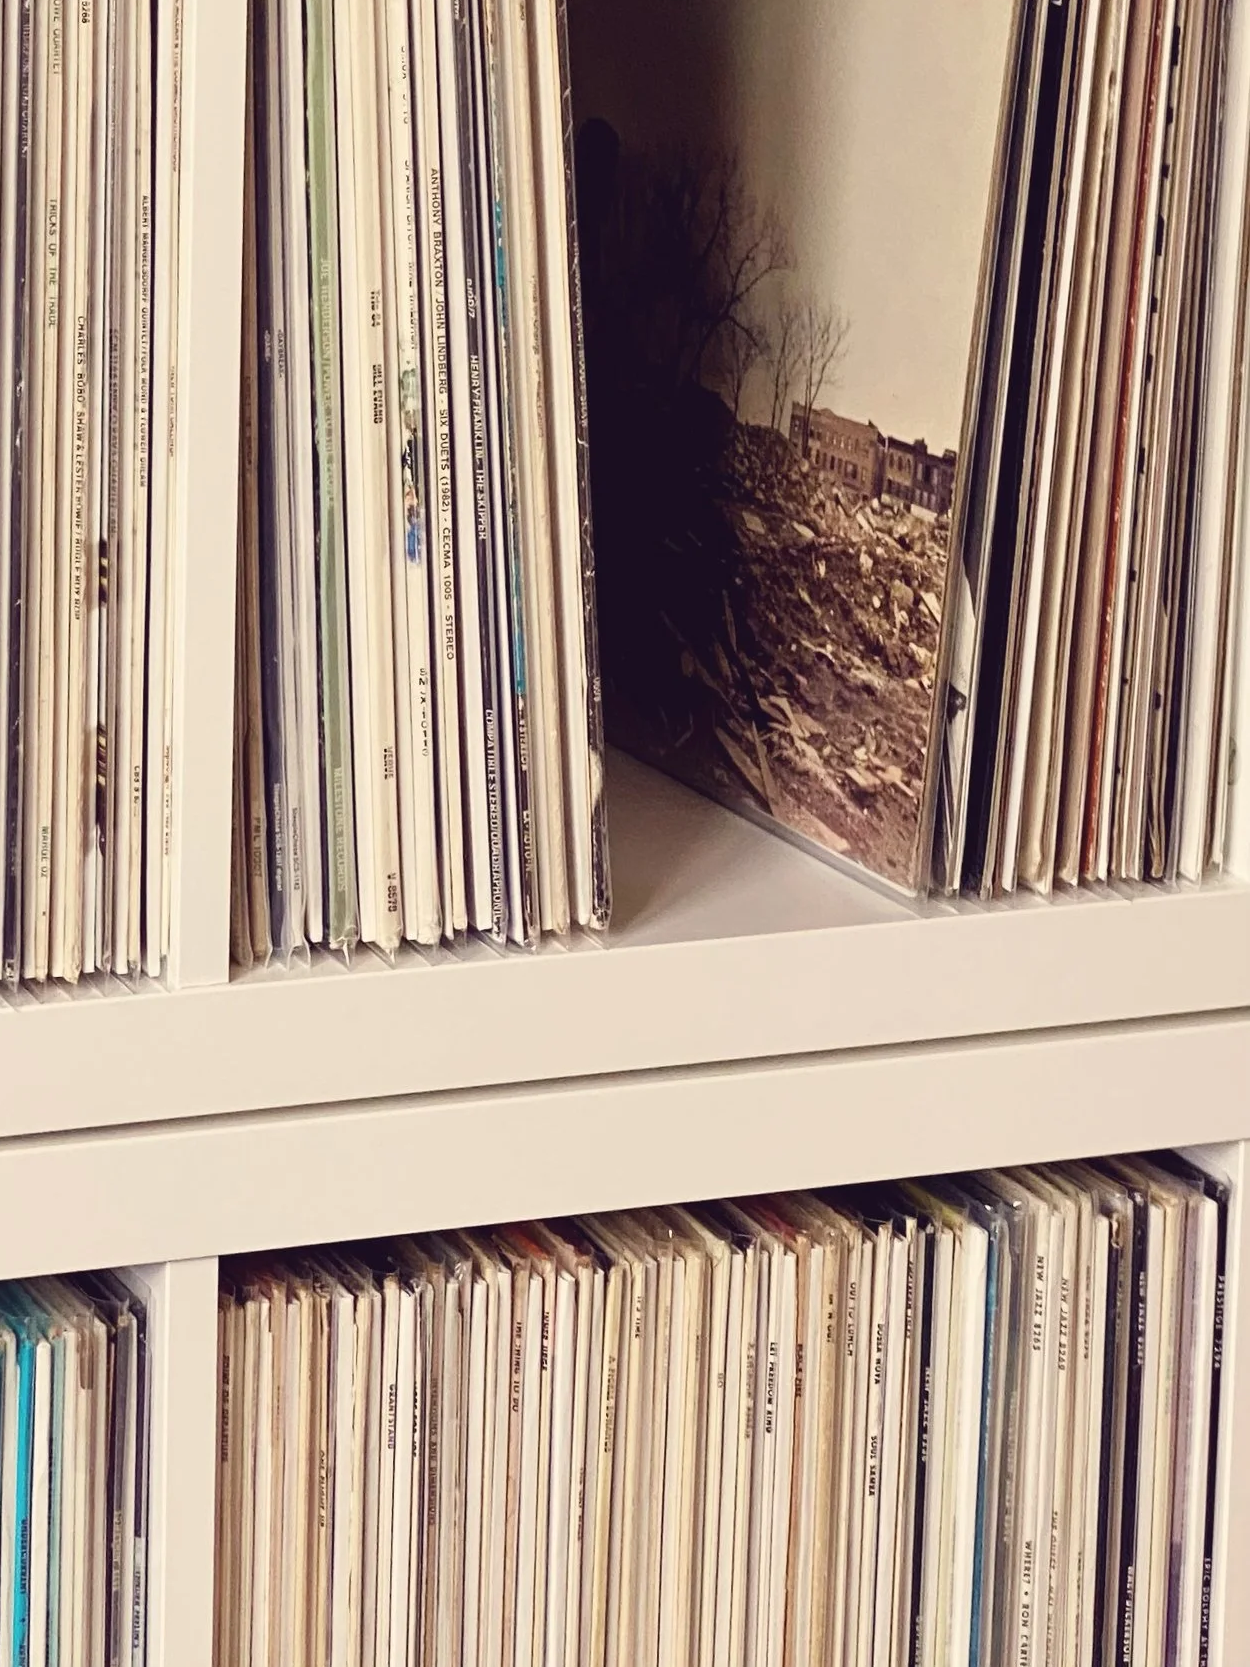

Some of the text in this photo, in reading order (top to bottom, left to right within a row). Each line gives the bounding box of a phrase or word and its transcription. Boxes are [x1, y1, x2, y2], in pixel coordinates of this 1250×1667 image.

[431, 168, 442, 225] ANTHONY
[49, 199, 57, 236] TRICKS
[49, 243, 57, 257] OF
[433, 231, 444, 287] BRAXTON
[48, 267, 57, 285] THE
[435, 297, 445, 329] JOHN
[77, 316, 86, 365] CHARLES
[437, 335, 447, 394] LINDBERG
[470, 355, 481, 394] HENRY
[76, 411, 85, 441] SHAW
[439, 409, 449, 427] SIX
[440, 432, 450, 471] DUETS
[75, 454, 83, 493] LESTER
[476, 468, 485, 491] THE
[439, 475, 451, 512] (1982)
[477, 494, 487, 540] SKIPPER
[442, 527, 451, 569] CECMA
[445, 614, 455, 660] STEREO
[1036, 1255, 1045, 1282] NEW
[849, 1282, 857, 1300] OUT
[1034, 1288, 1043, 1317] JAZZ
[1059, 1277, 1069, 1336] NEW JAZZ
[1215, 1275, 1225, 1329] PRESTIGE
[848, 1306, 856, 1319] TO
[766, 1342, 778, 1434] LET FREEDOM RING
[868, 1435, 878, 1496] SOUL SAMBA
[1021, 1603, 1030, 1627] RON
[1201, 1557, 1211, 1647] ERIC DOLPHY AT
